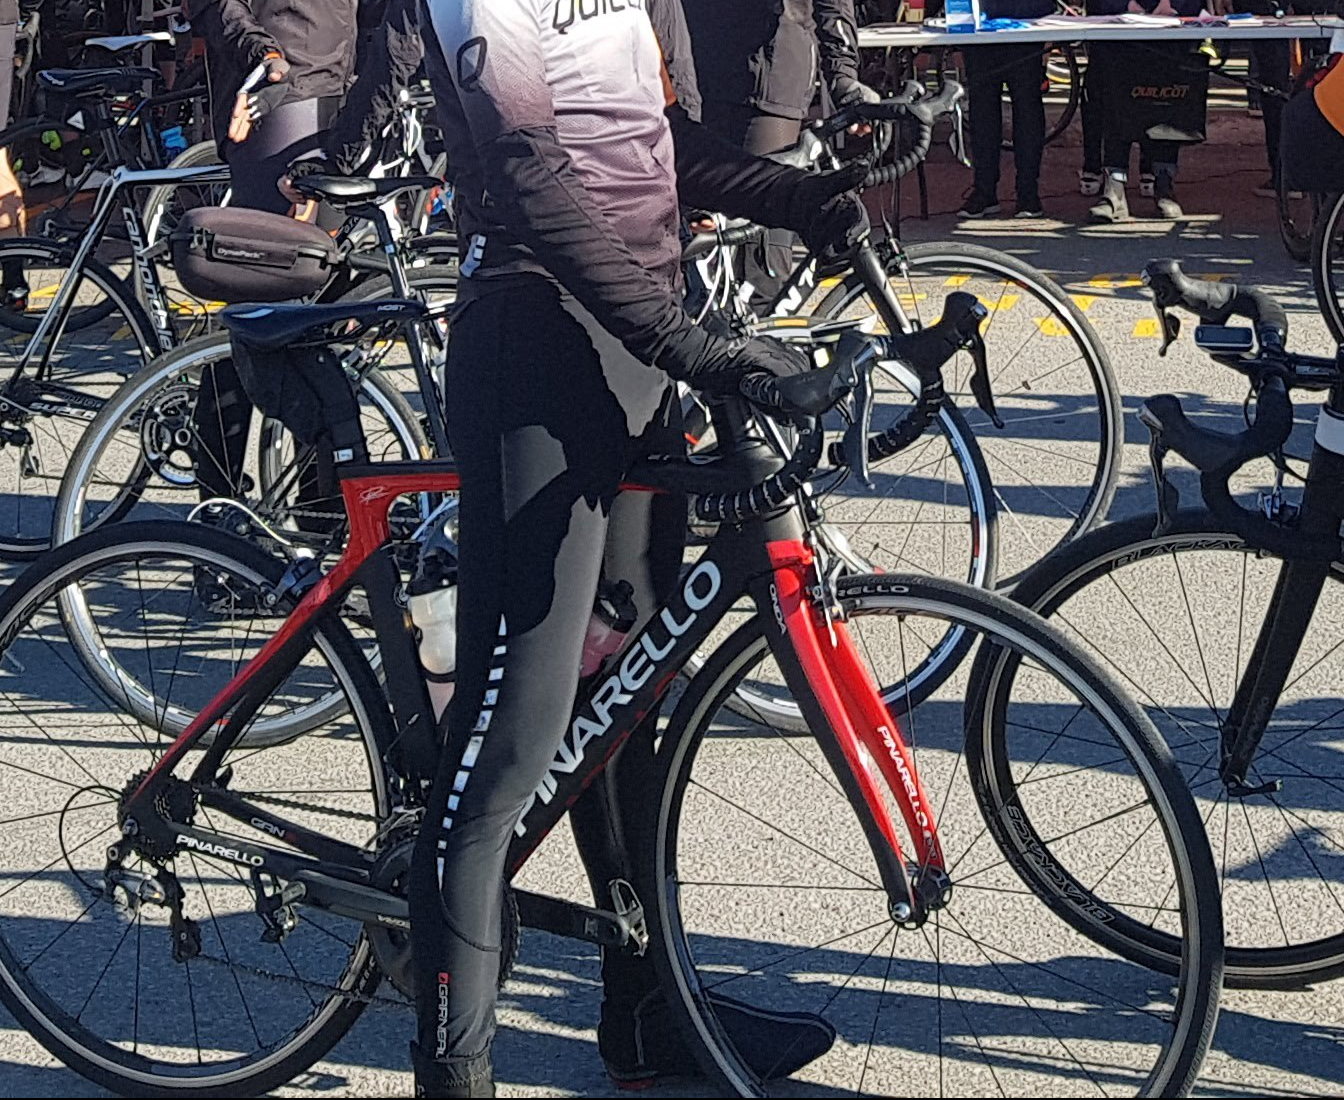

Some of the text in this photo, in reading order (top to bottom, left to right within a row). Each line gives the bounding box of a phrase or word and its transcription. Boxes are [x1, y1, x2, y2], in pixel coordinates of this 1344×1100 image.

[1130, 84, 1191, 100] QUILICOT
[121, 206, 175, 351] cannondale
[768, 582, 787, 636] ONDA
[512, 559, 722, 838] PINARELLO
[876, 724, 929, 829] PINARELLO
[175, 833, 265, 867] PINARELLO
